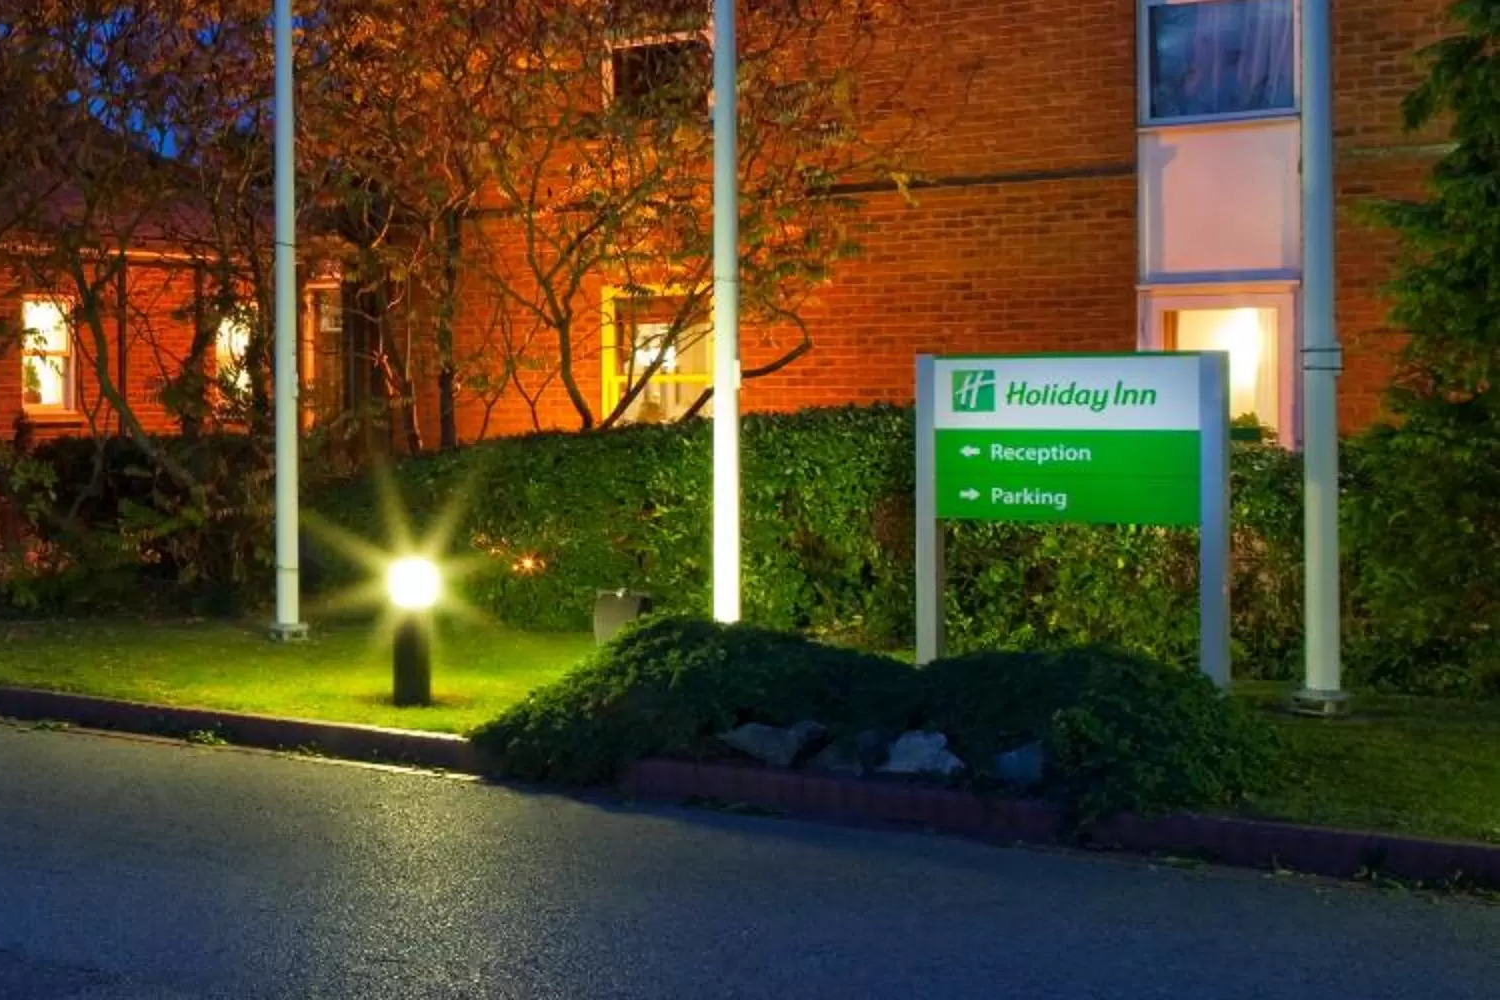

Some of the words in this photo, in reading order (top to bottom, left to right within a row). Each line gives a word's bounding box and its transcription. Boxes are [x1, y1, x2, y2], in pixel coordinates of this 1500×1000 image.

[1006, 380, 1109, 412] Holiday
[1114, 380, 1157, 406] Inn
[990, 443, 1092, 465] Reception
[991, 487, 1068, 511] Parking
